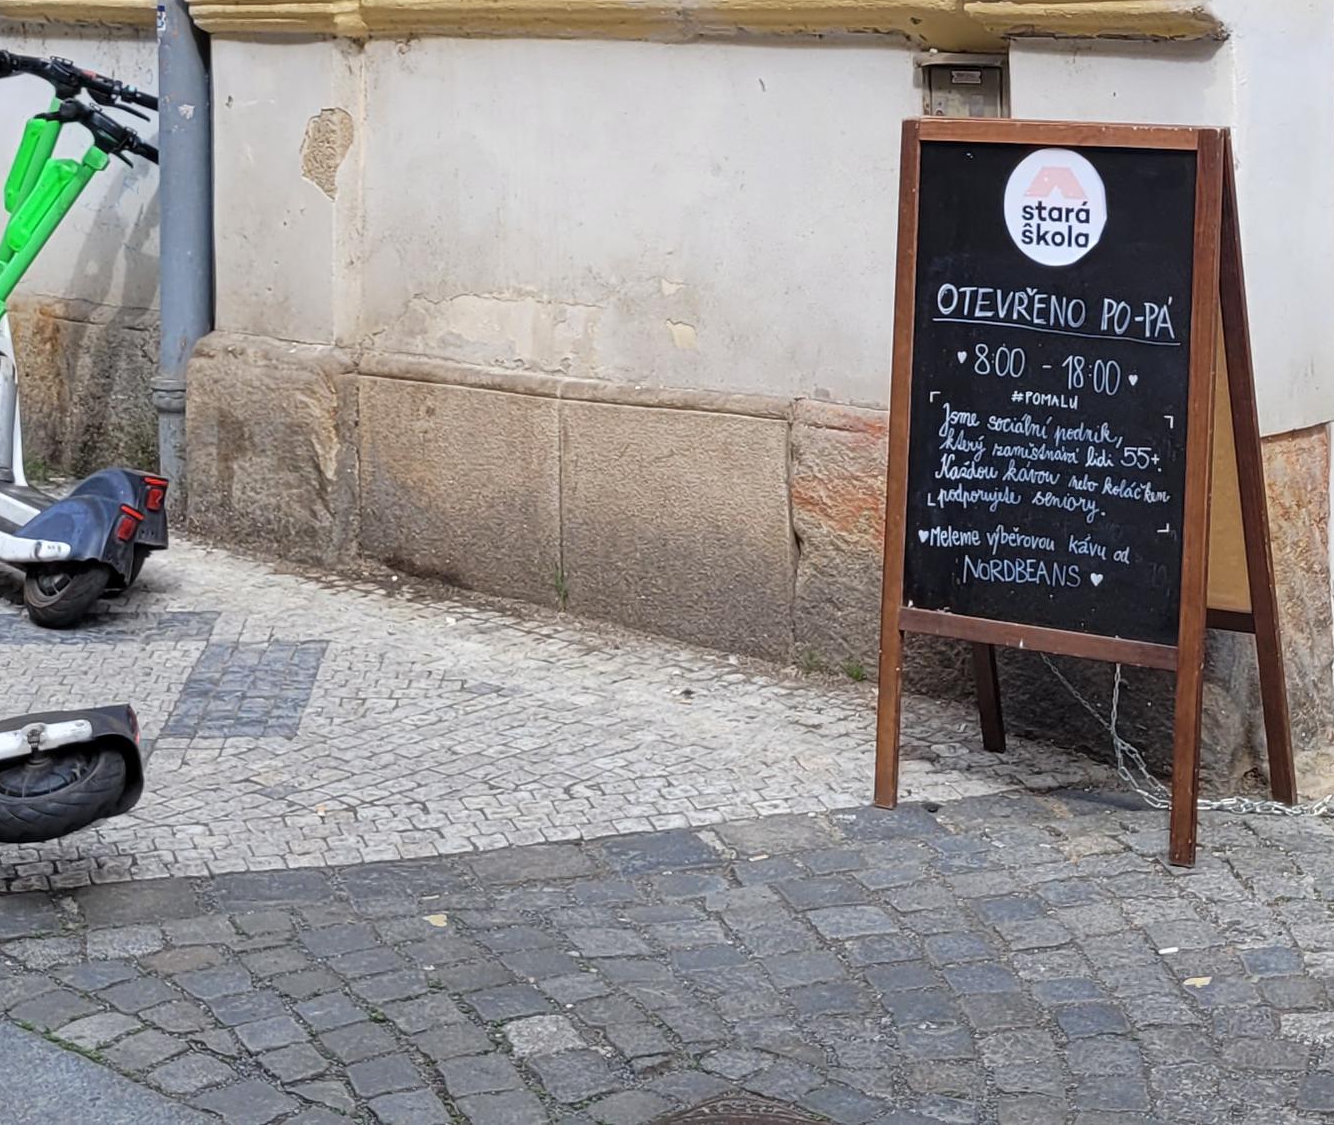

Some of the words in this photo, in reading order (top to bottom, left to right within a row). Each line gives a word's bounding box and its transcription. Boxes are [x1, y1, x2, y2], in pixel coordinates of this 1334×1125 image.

[1021, 200, 1091, 224] stará
[937, 283, 1087, 328] OTEVŘENO
[1100, 296, 1176, 340] PO-PÁ
[974, 343, 1026, 378] 8:00
[1062, 355, 1121, 396] 18:00
[1010, 390, 1079, 410] #POMALU
[938, 402, 981, 437] Jsme
[987, 416, 1053, 440] sociální
[1053, 421, 1123, 449] podnik,
[939, 427, 986, 462] který
[992, 441, 1080, 464] zaměstnává
[1085, 448, 1115, 468] lidi
[937, 482, 1022, 513] podporujete
[1002, 460, 1061, 485] kávou
[1068, 473, 1099, 492] nebo
[1102, 477, 1170, 503] koláčkem
[929, 525, 981, 548] Meleme
[985, 523, 1056, 556] výběrovou
[1068, 533, 1107, 561] kávu
[1113, 546, 1131, 565] od
[962, 554, 1082, 588] NORDBEANS
